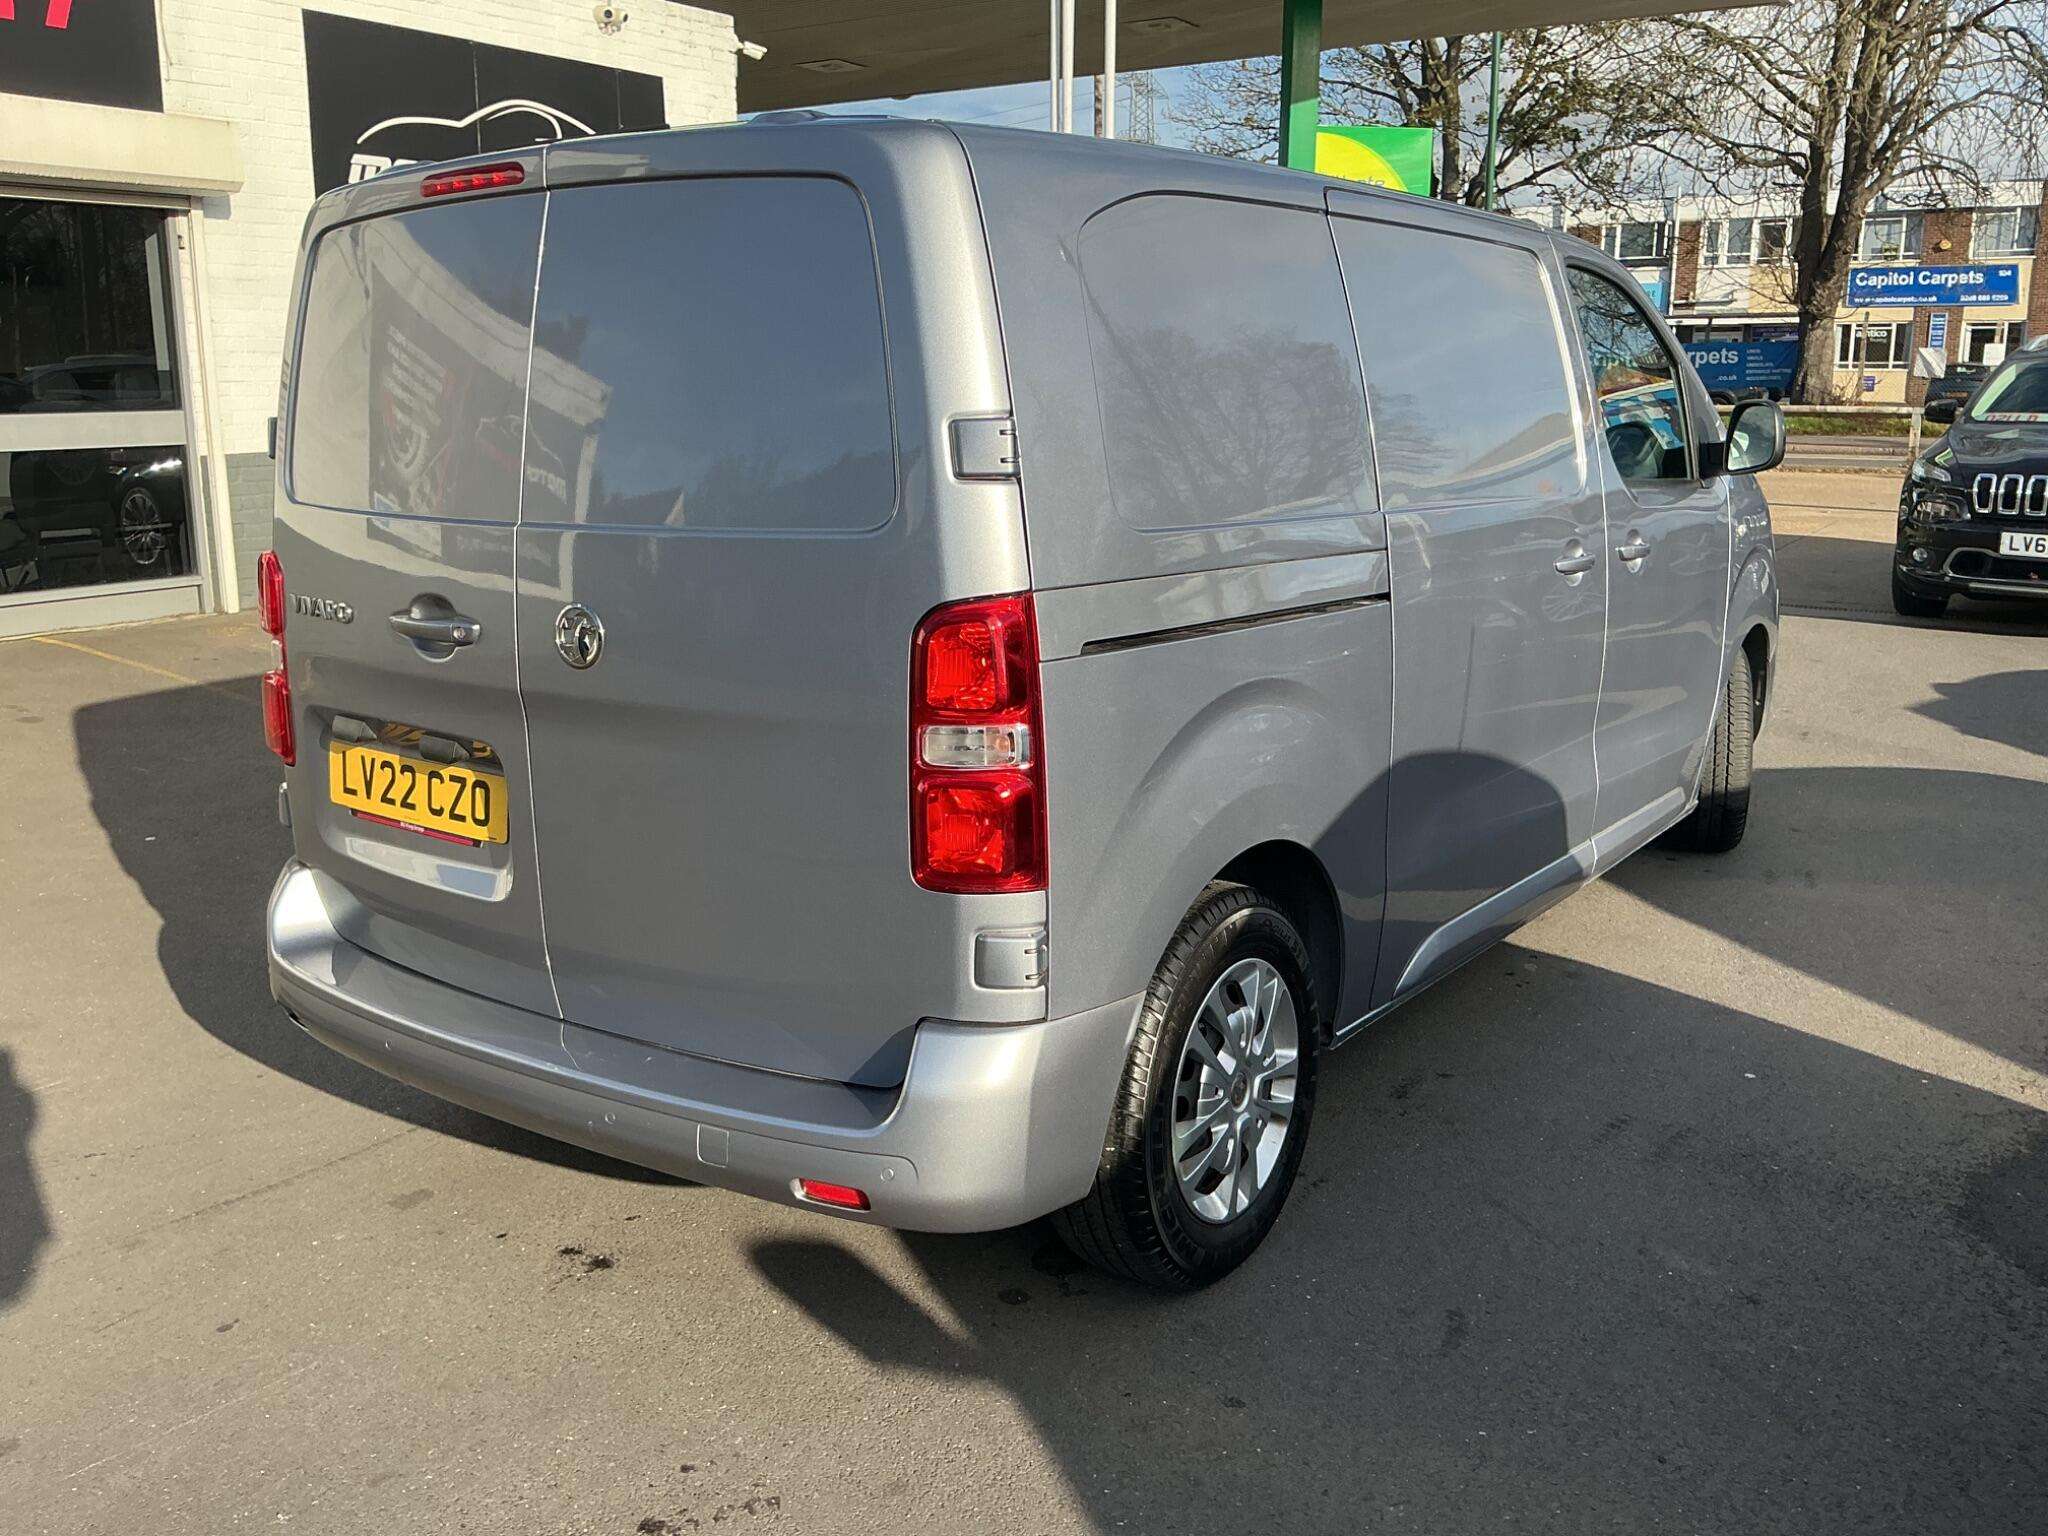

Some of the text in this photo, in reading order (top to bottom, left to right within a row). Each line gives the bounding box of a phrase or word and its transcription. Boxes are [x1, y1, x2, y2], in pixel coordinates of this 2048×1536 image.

[1855, 270, 1984, 289] Capitol Carpets
[1687, 347, 1739, 369] rpets
[2008, 535, 2047, 553] LV6
[341, 750, 491, 827] LV22 CZO
